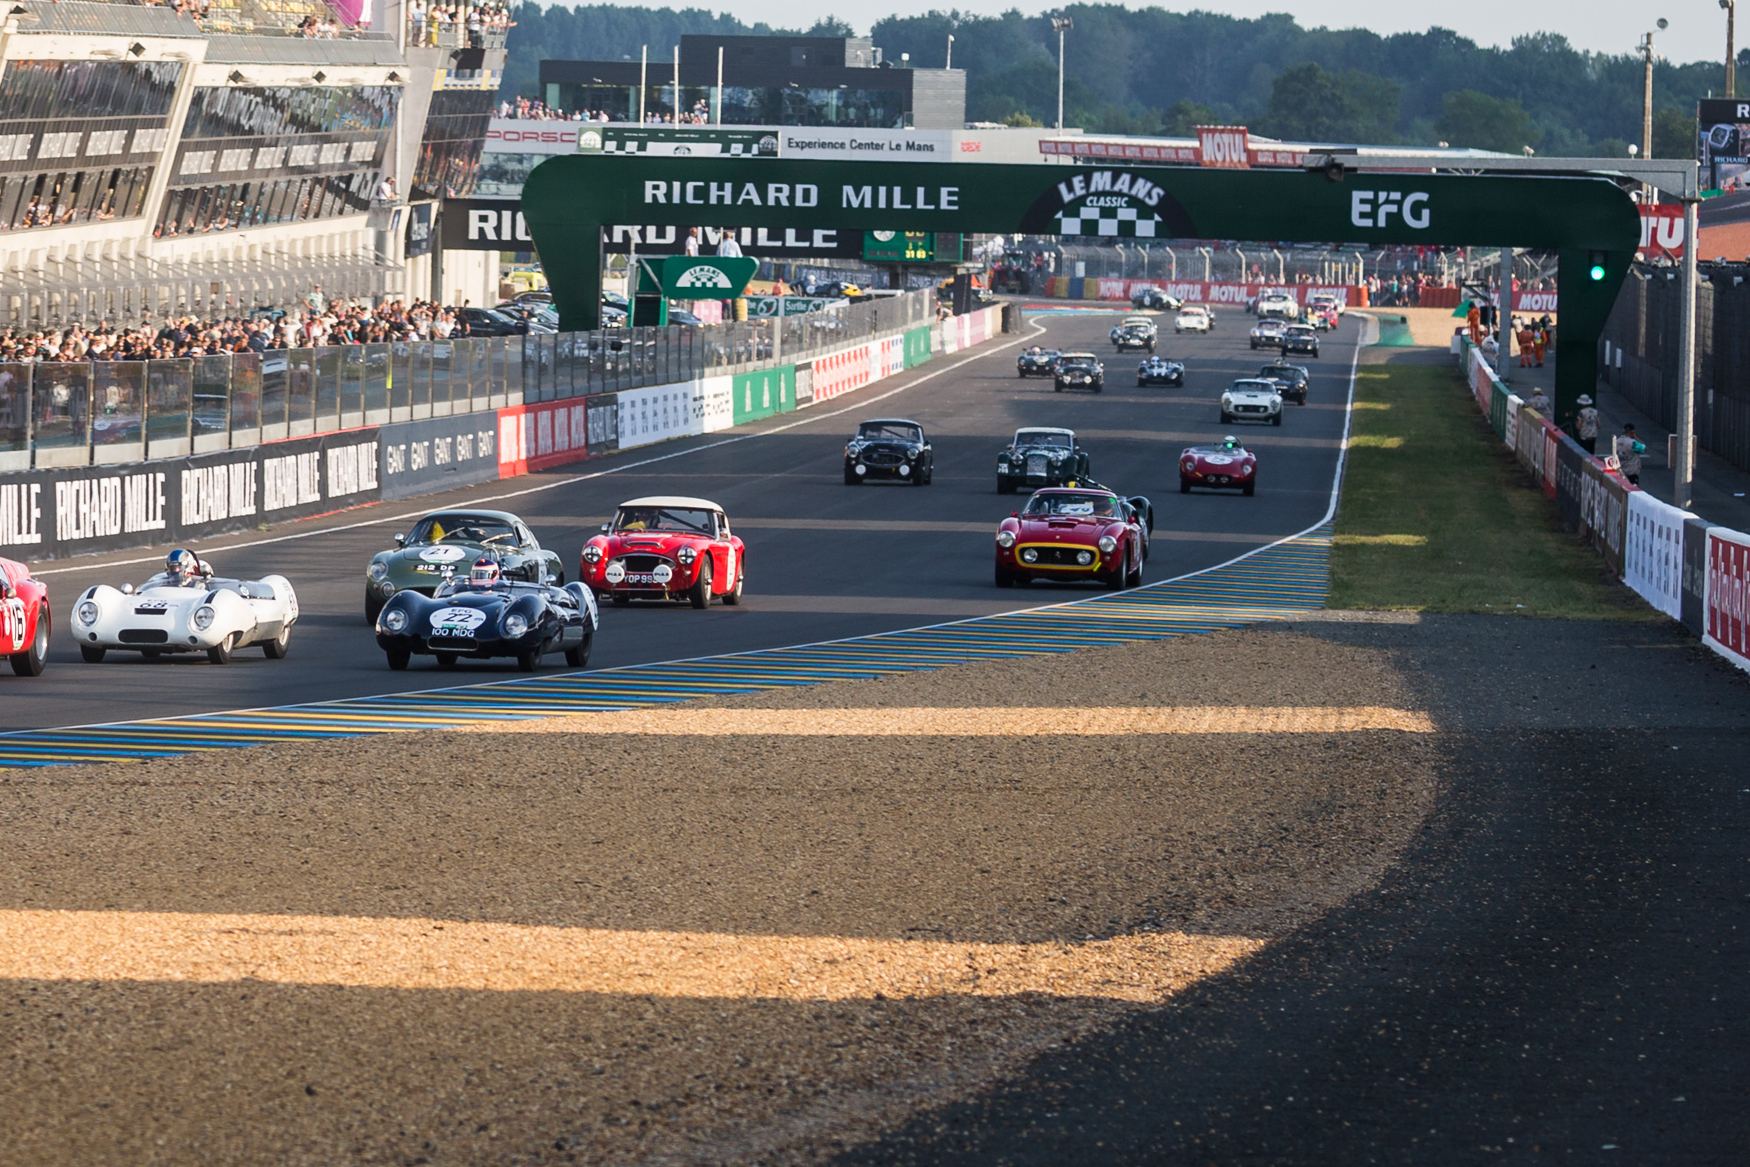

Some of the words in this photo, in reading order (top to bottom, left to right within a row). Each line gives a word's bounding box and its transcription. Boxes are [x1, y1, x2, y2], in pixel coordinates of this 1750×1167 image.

[486, 130, 576, 144] PORSC
[788, 138, 846, 152] Experience
[850, 139, 885, 151] Center
[889, 140, 902, 151] Le
[906, 141, 935, 153] Mans
[1202, 133, 1247, 163] MOTUL
[644, 180, 819, 208] RICHARD
[840, 185, 959, 211] MILLE
[1057, 174, 1087, 204] LE
[1088, 171, 1166, 207] MANS
[1086, 196, 1129, 207] CLASSIC
[1351, 190, 1430, 229] EFG
[1167, 284, 1202, 300] MOTUL
[1209, 285, 1250, 302] MOTUL
[1518, 293, 1557, 311] MOTU
[181, 465, 228, 526] RICHARD
[229, 461, 257, 517] MILLE
[55, 476, 122, 541] RICHARD
[124, 472, 166, 533] MILLE
[429, 546, 449, 555] 21
[442, 613, 473, 622] 22
[432, 628, 449, 636] 100
[452, 629, 475, 638] MDG
